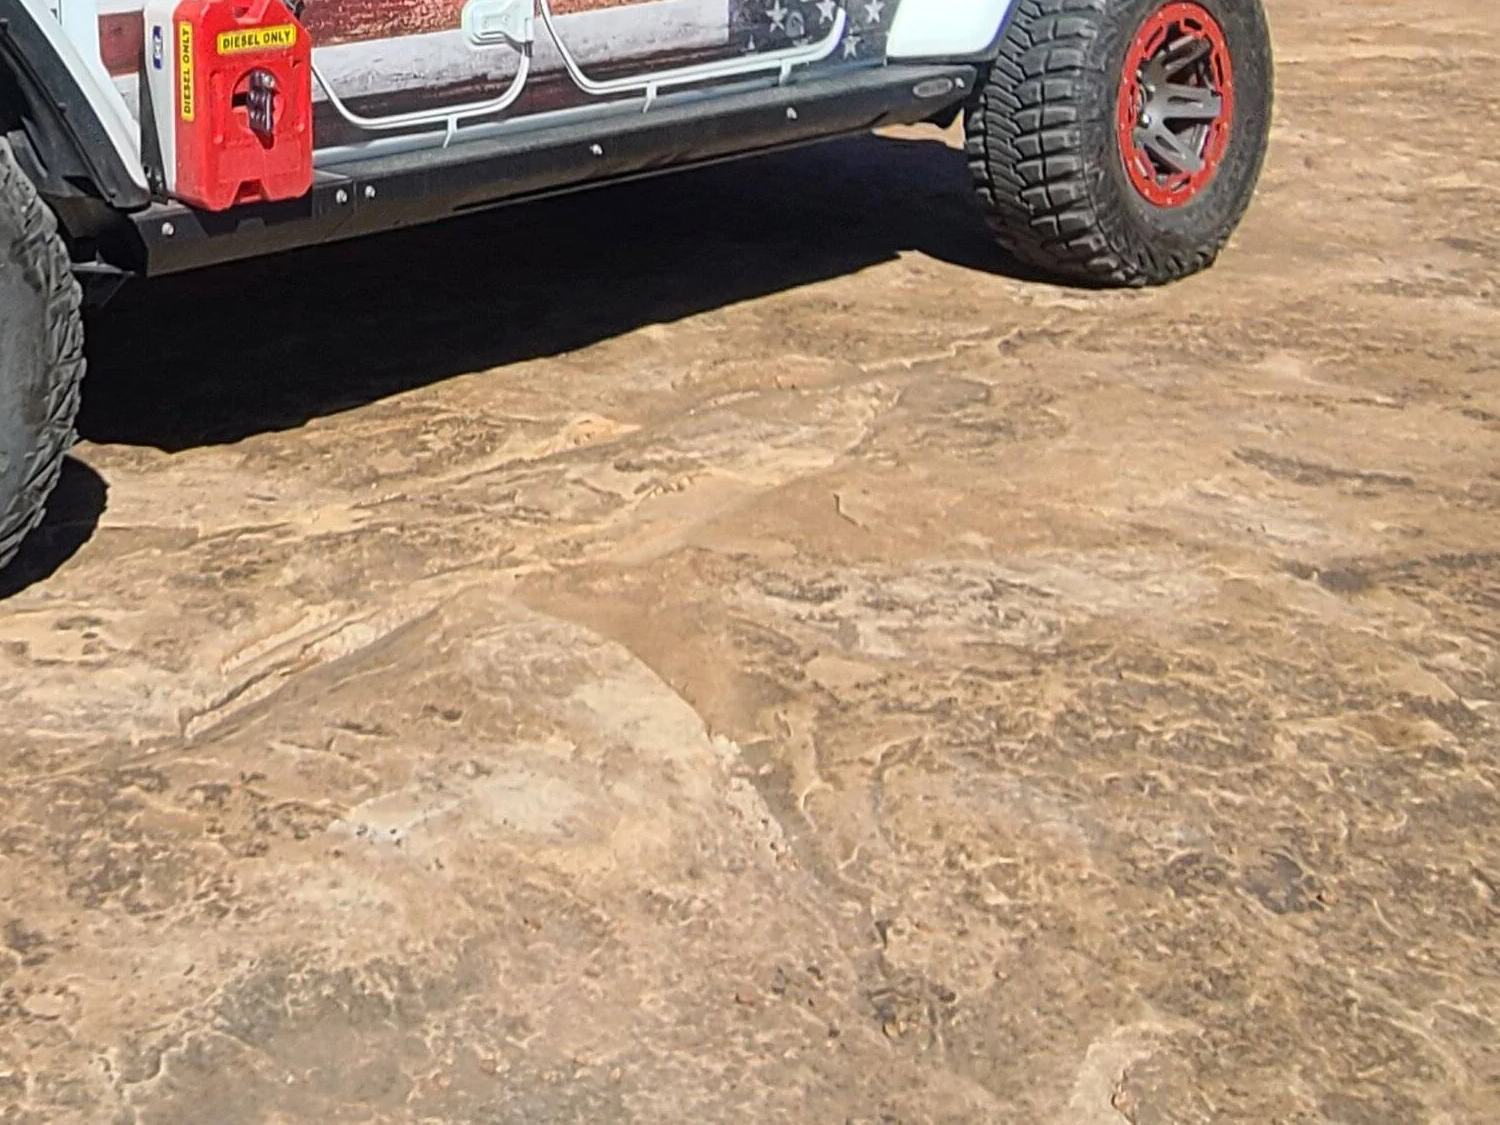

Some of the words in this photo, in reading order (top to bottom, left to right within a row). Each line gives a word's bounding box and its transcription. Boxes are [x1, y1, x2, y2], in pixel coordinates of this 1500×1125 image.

[182, 28, 190, 63] ONLY
[223, 35, 260, 49] DIESEL
[263, 30, 291, 44] ONLY
[183, 68, 191, 114] DIESEL
